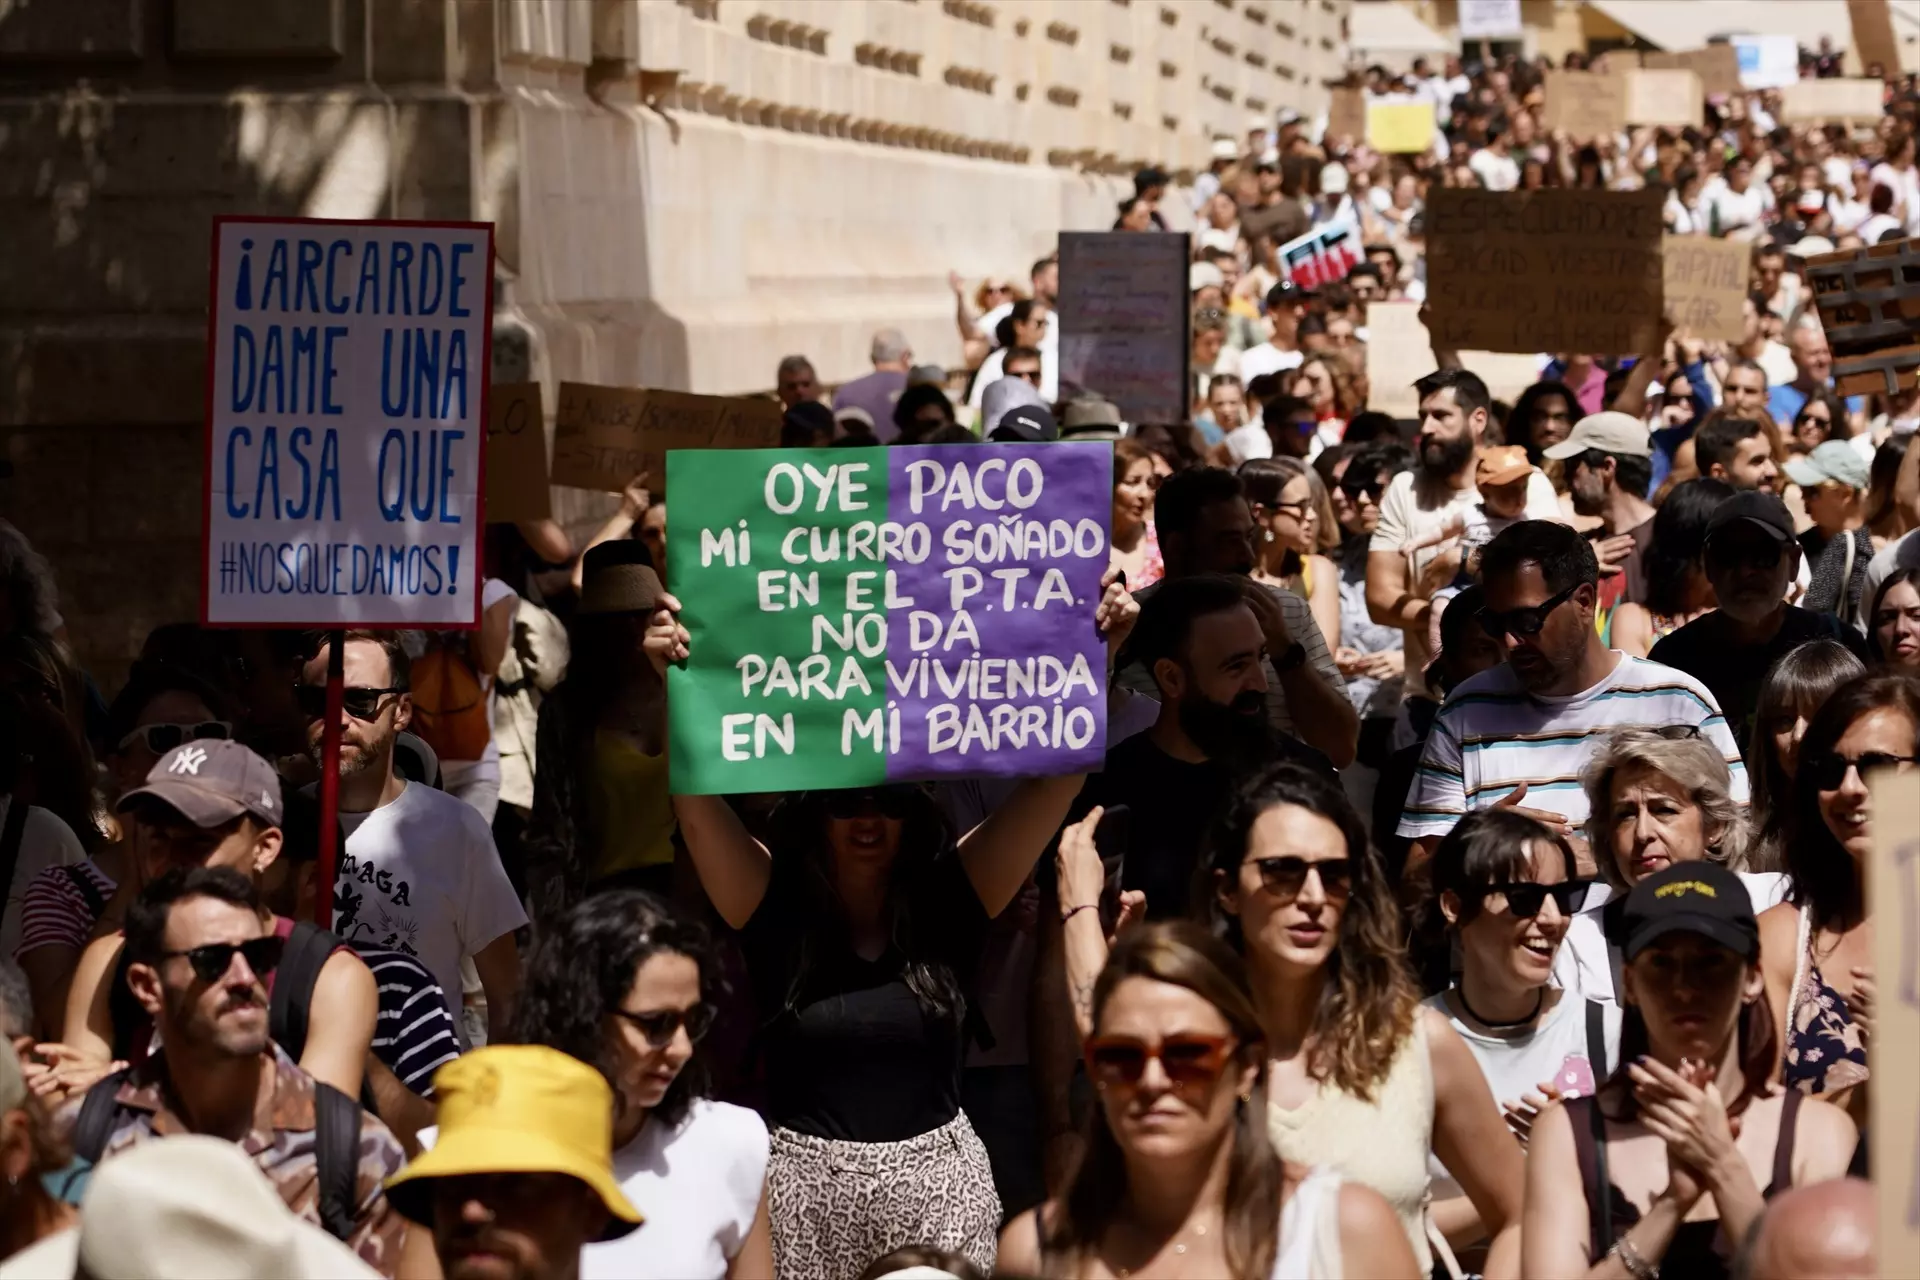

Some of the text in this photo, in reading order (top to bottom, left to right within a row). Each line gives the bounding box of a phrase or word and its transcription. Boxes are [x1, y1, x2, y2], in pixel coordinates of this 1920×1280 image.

[234, 238, 474, 317] ¡ARCARDE
[231, 324, 467, 419] DAME UNA
[226, 427, 466, 523] CASA QUE
[764, 458, 1044, 515] OYE PACO
[781, 520, 931, 564] CURRO
[943, 513, 1105, 564] SOÑADO
[220, 541, 459, 596] #NOSQUEDAMOS!
[757, 567, 1085, 612] EN EL P.T.A.
[812, 609, 981, 658] NO DA
[736, 653, 873, 700] PARA
[721, 712, 794, 762] EN
